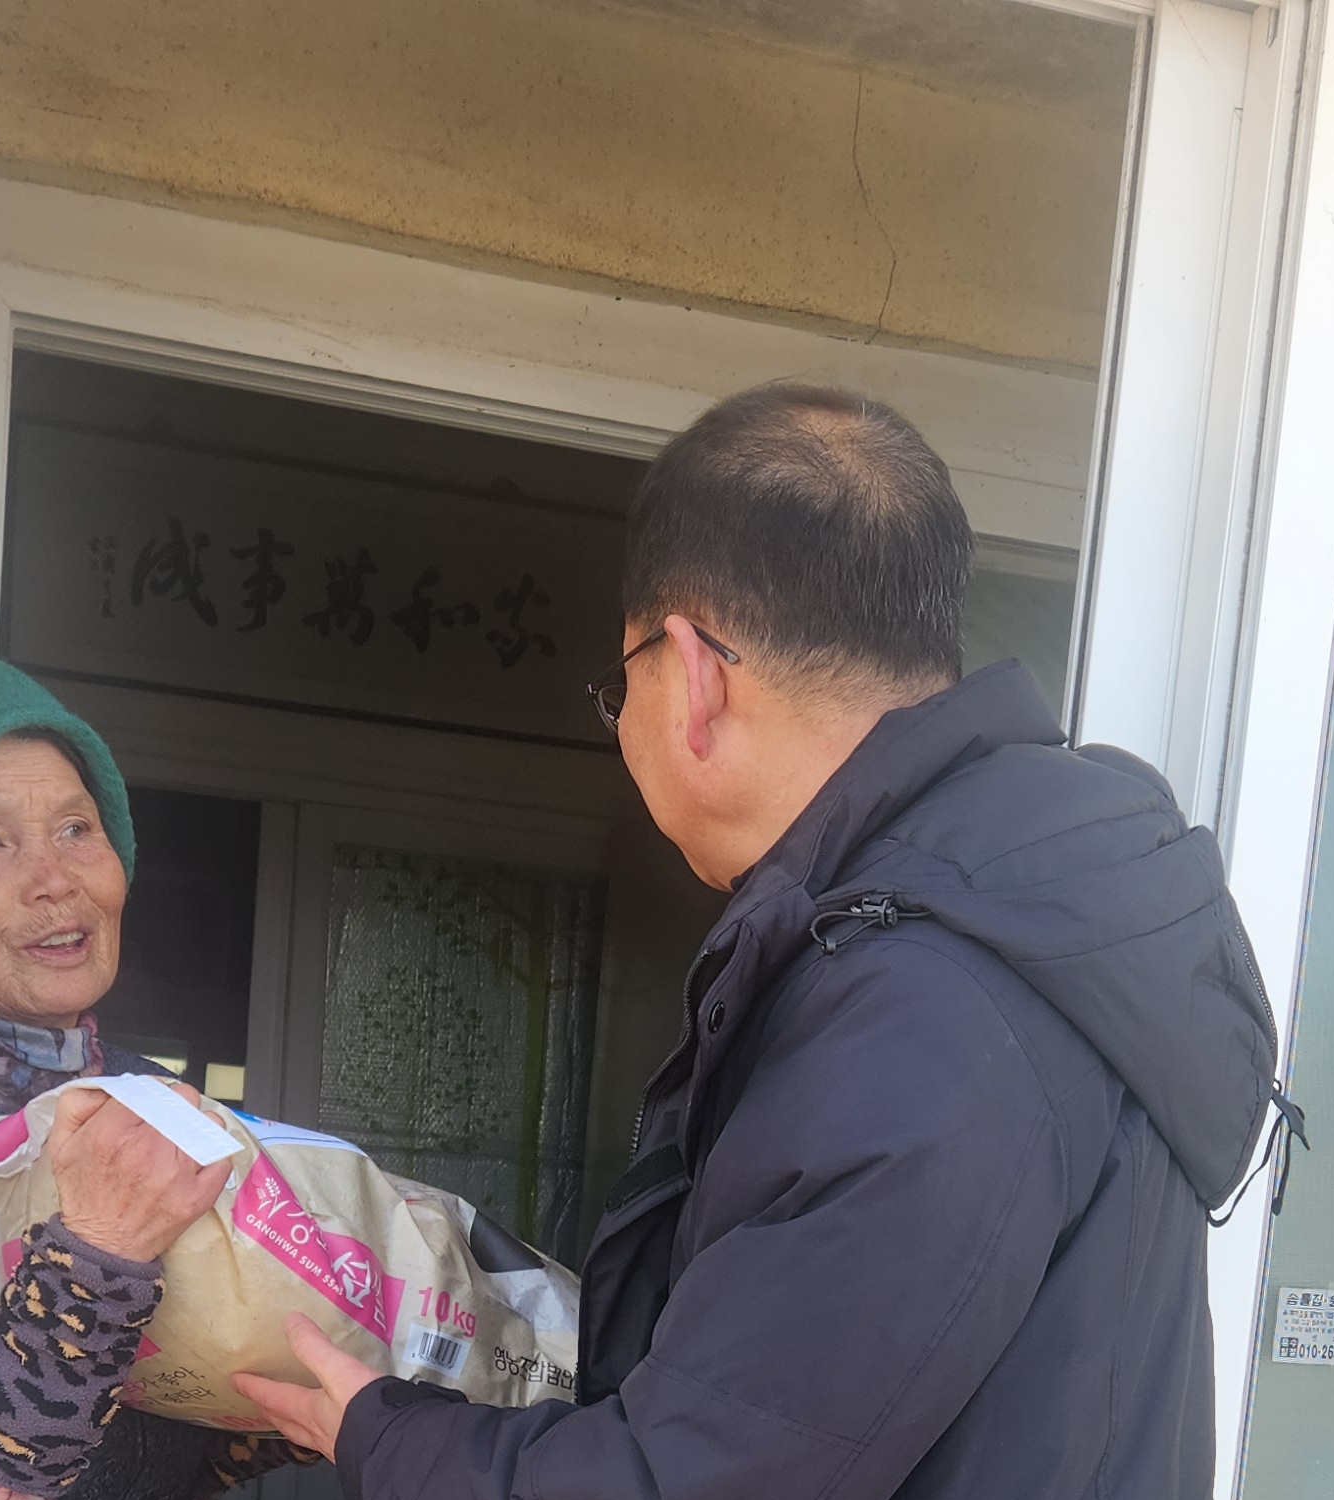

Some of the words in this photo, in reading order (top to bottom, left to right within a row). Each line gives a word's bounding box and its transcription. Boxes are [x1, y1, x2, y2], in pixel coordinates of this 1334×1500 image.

[245, 1213, 298, 1259] GANGHWA
[299, 1254, 323, 1278] SUM
[322, 1273, 345, 1297] SSAL
[418, 1286, 477, 1338] 10kg
